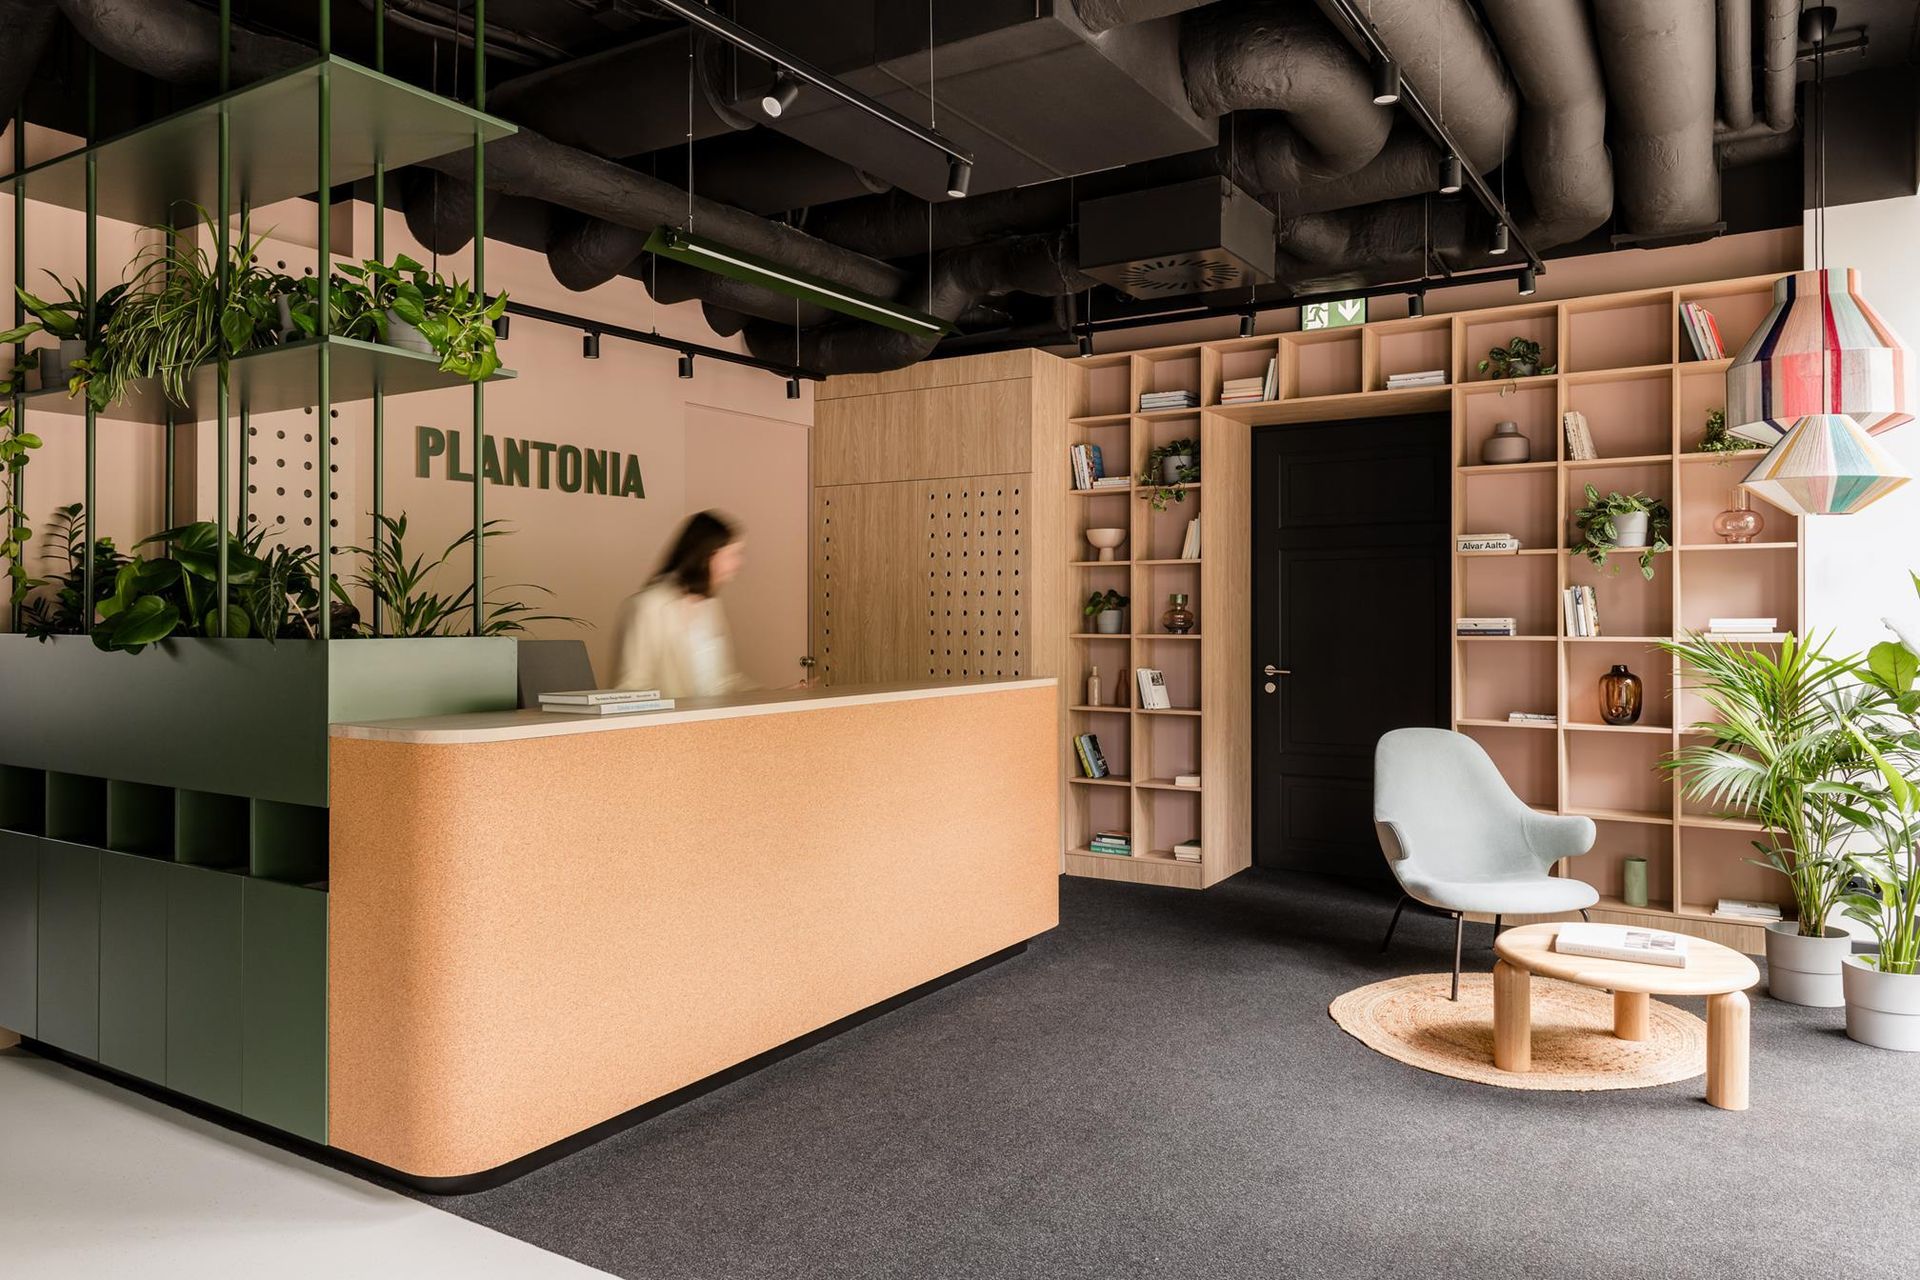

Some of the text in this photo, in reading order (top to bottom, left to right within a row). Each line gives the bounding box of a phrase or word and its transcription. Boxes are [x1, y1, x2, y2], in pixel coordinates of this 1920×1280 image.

[415, 425, 645, 499] PLANTONIA
[1462, 541, 1507, 550] Alvar Aalto
